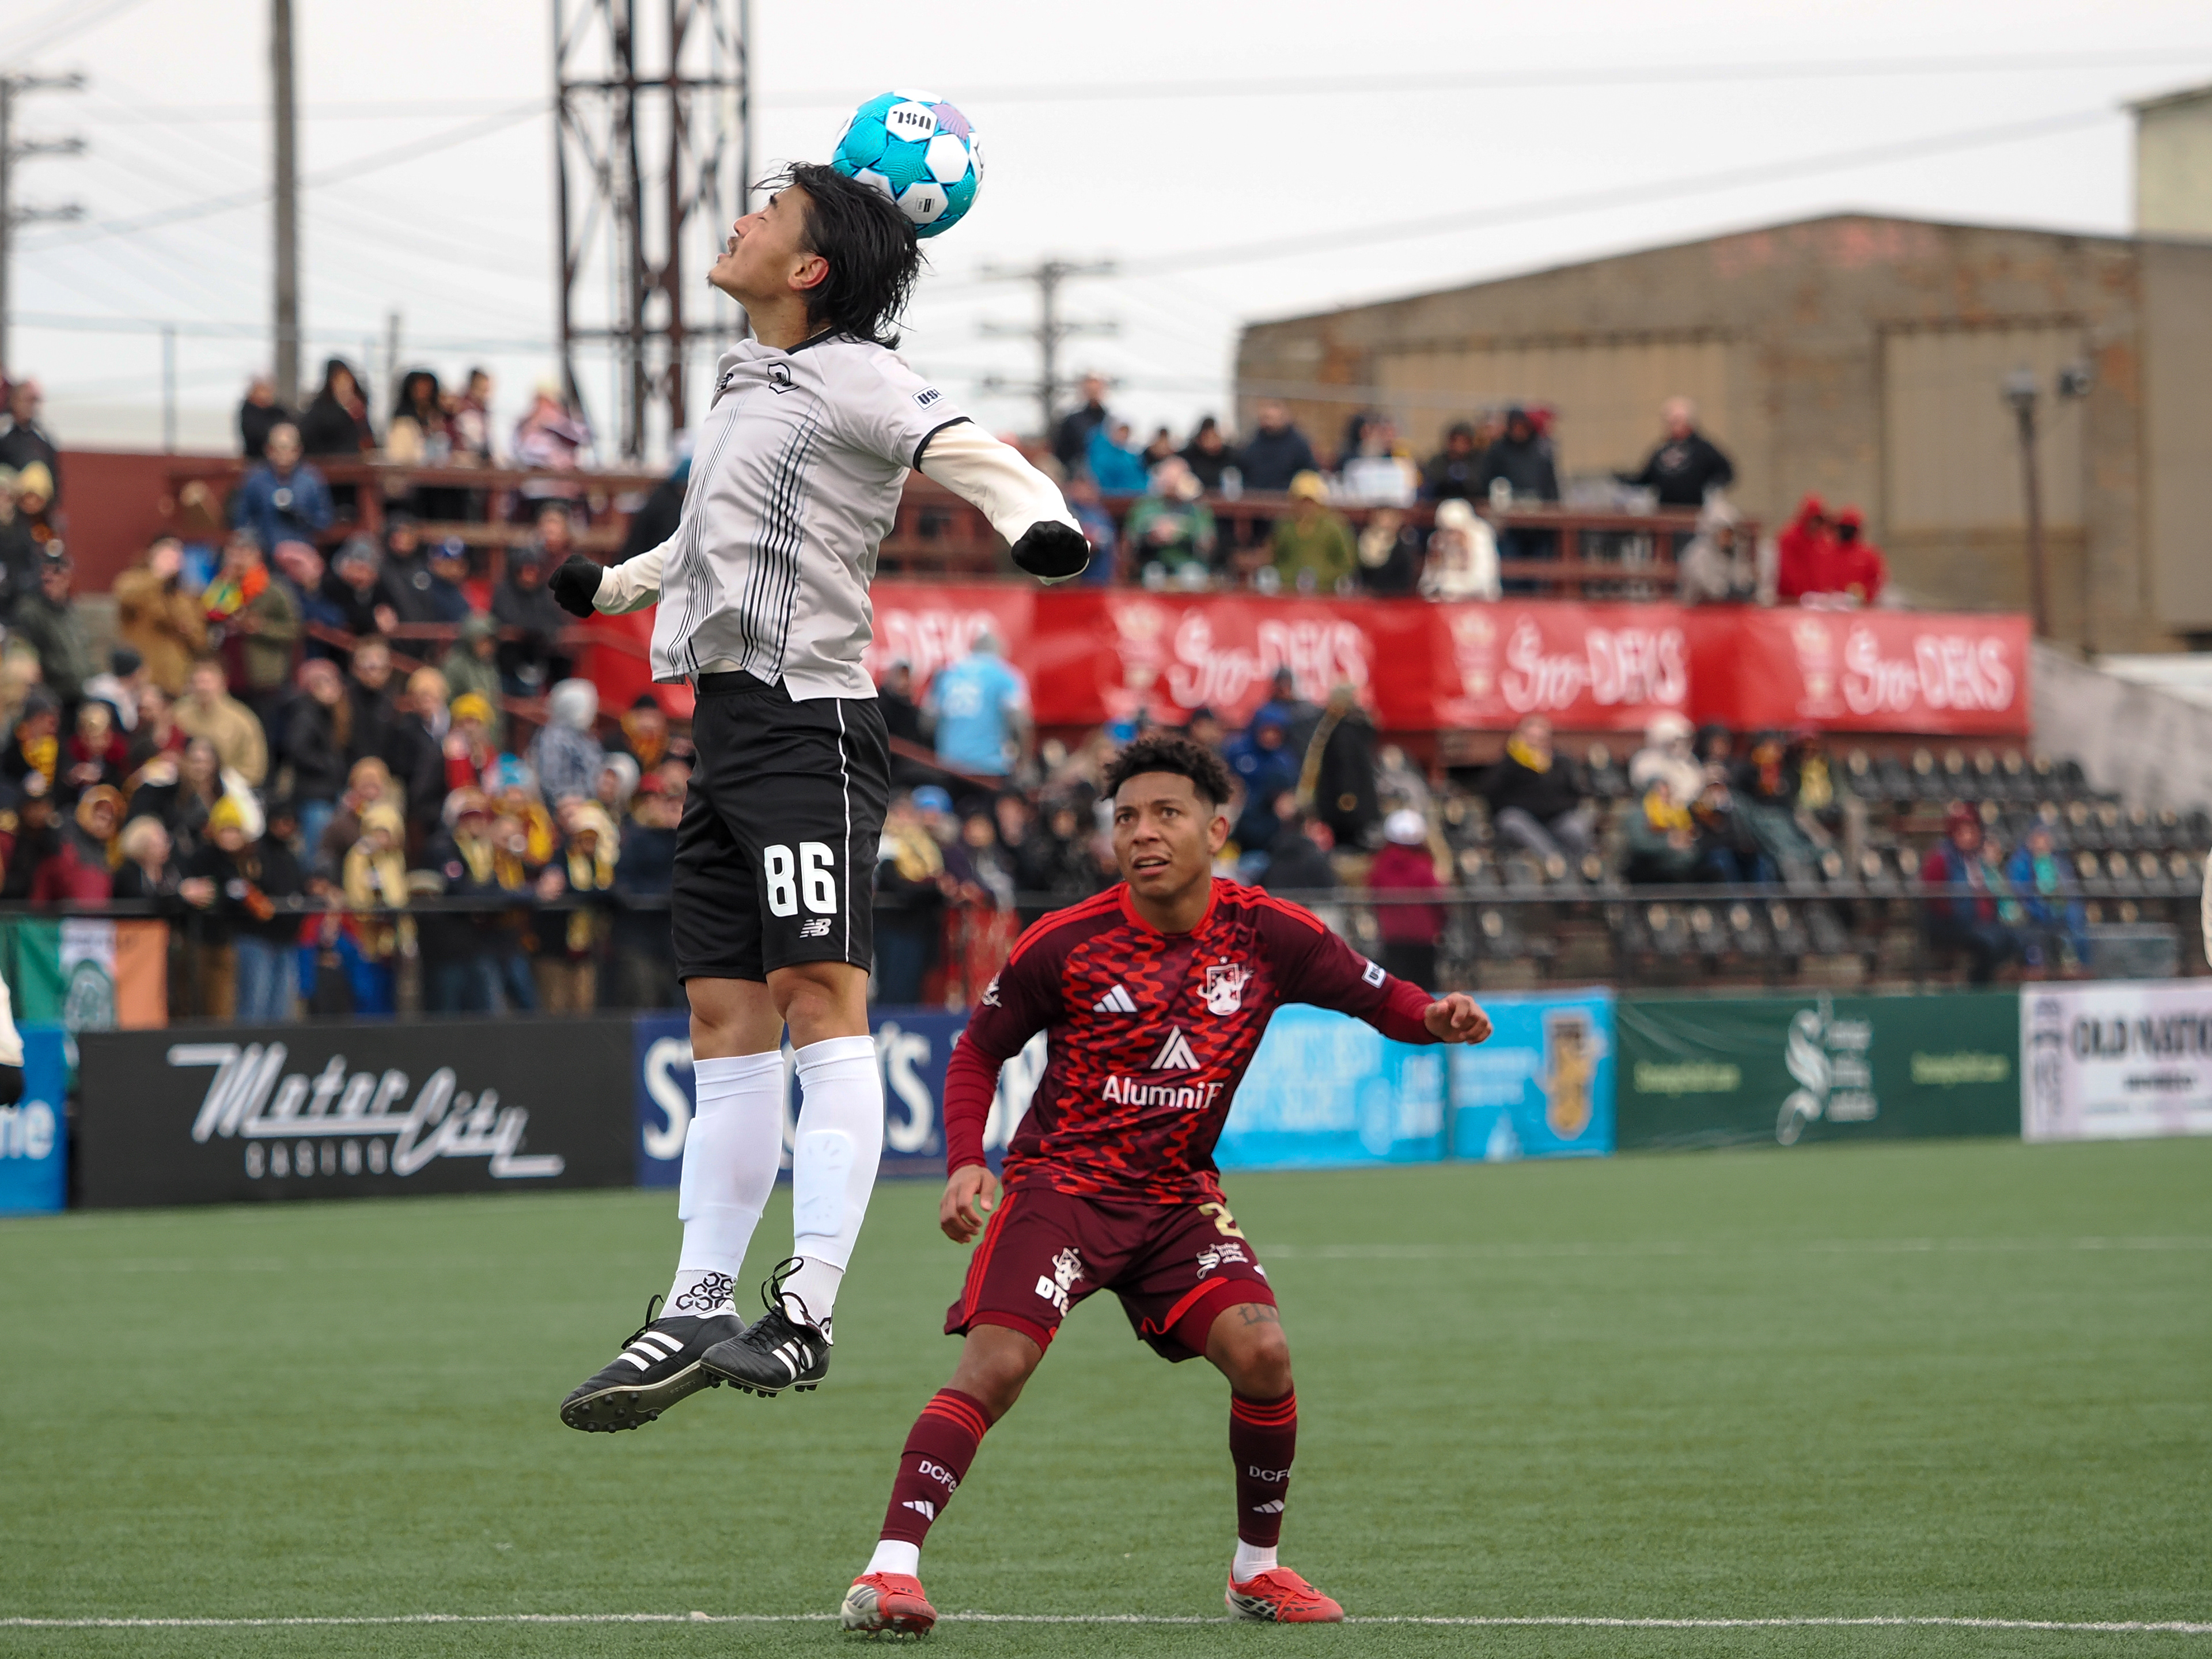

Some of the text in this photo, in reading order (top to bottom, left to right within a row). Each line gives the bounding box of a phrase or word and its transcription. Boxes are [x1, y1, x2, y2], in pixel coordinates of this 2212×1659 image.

[892, 111, 931, 130] USL
[764, 842, 837, 917] 86
[168, 1041, 410, 1143] Motor
[392, 1066, 565, 1177] City
[918, 1460, 957, 1493] DCFC
